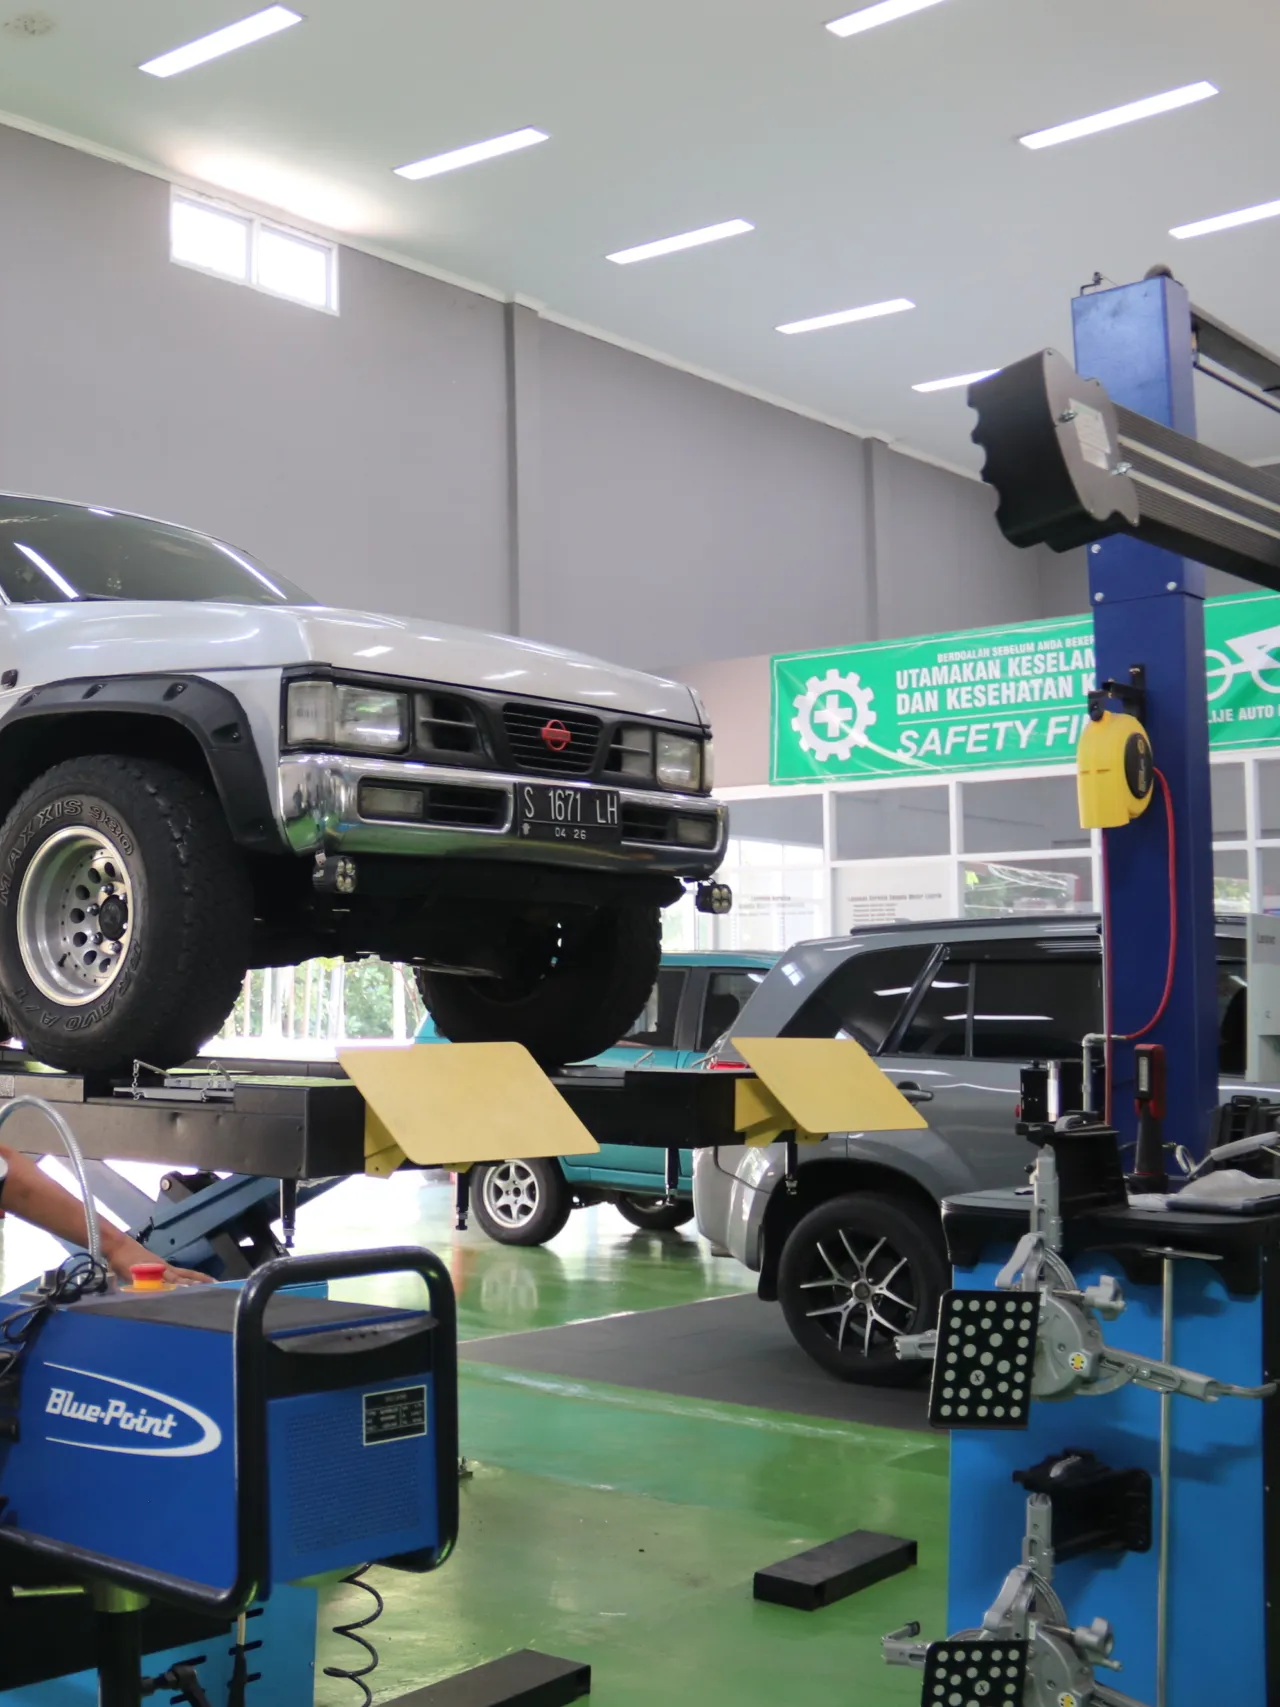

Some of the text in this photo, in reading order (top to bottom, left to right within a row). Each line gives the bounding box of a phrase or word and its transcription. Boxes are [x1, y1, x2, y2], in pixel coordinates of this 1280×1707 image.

[937, 648, 990, 663] BERDOALAH
[992, 642, 1035, 656] SEBELUM
[1038, 639, 1063, 651] ANDA
[896, 659, 1000, 690] UTAMAKAN
[896, 690, 939, 715] DAN
[946, 675, 1073, 710] KESEHATAN
[1238, 704, 1274, 721] AUTO
[896, 718, 1038, 758] SAFETY
[524, 786, 618, 825] S 1671 LH
[555, 827, 587, 840] 04 26
[45, 1387, 179, 1439] Blue-Point
